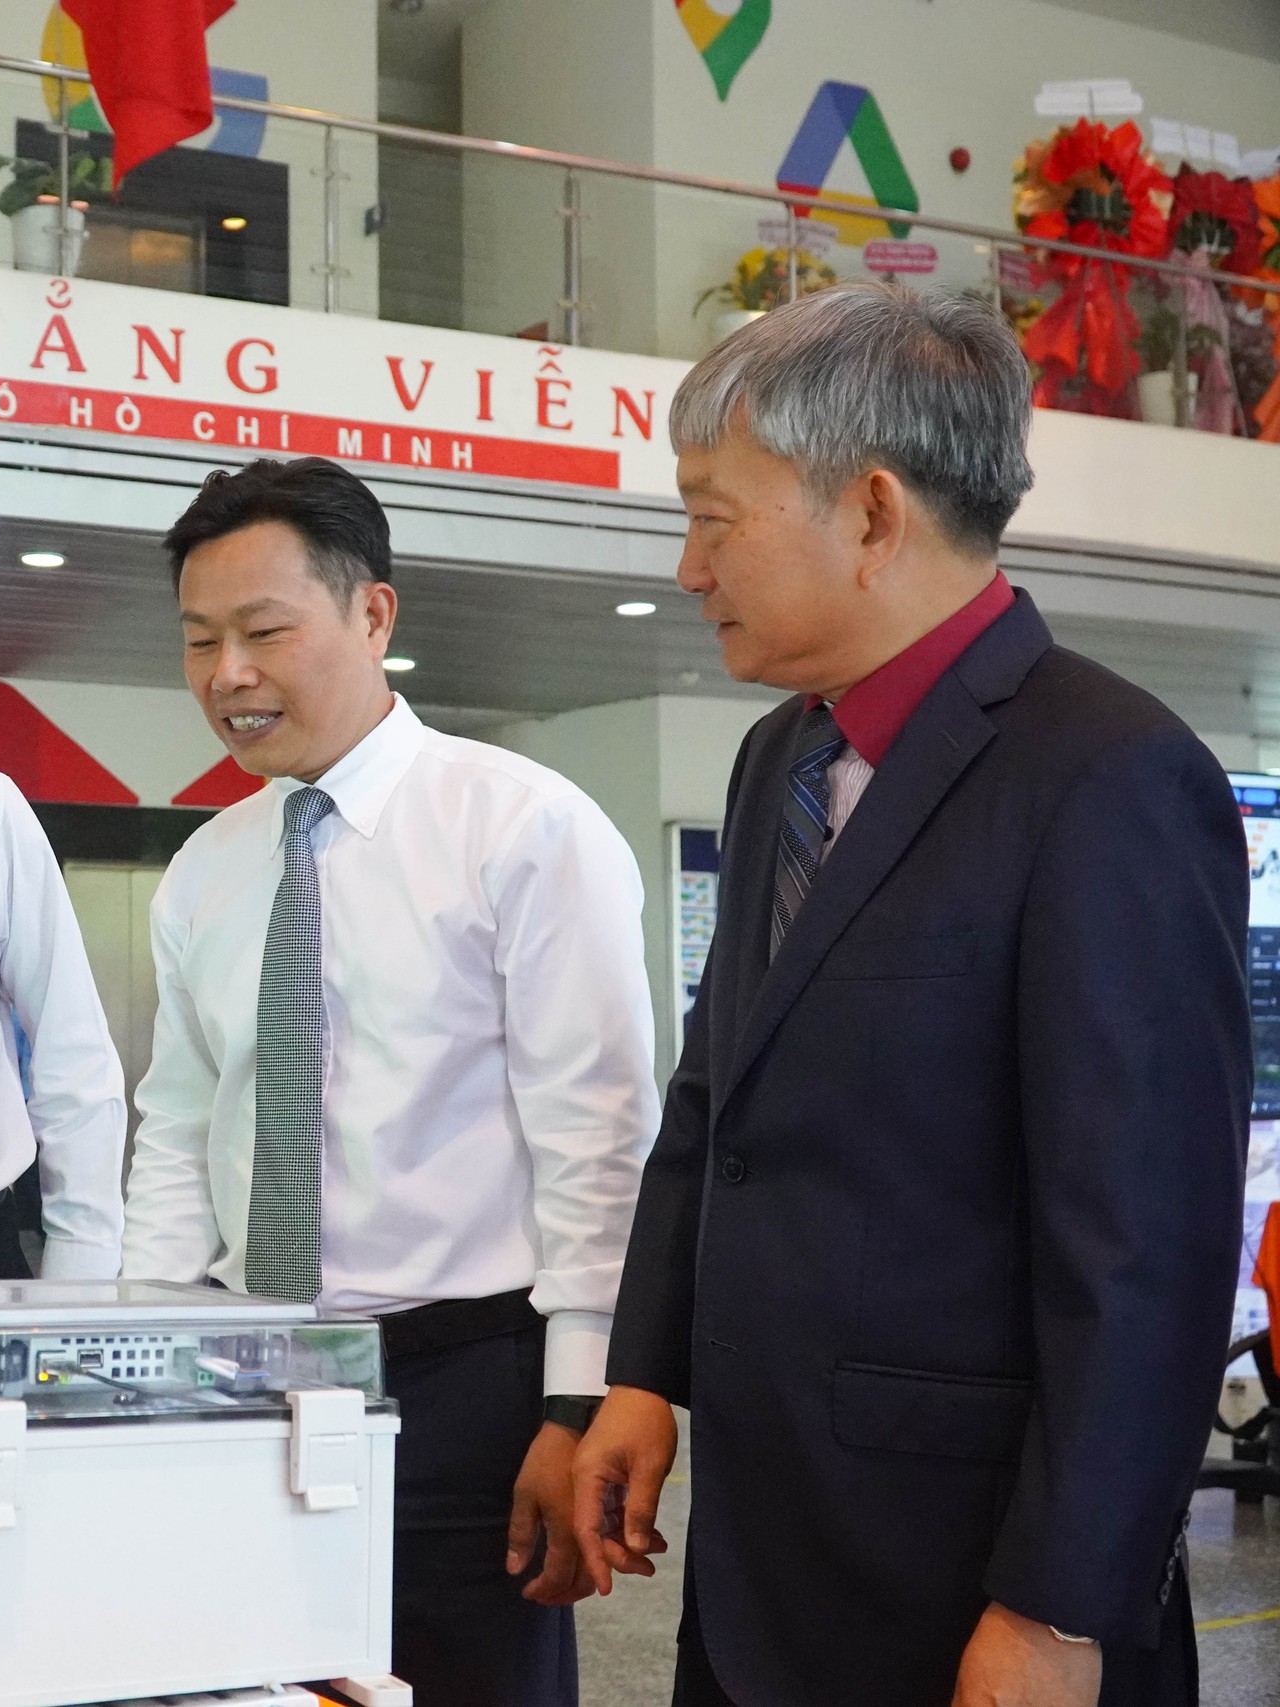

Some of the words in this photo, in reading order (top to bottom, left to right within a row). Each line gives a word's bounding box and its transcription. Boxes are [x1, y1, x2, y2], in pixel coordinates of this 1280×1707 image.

[386, 346, 655, 441] VIỄN
[192, 404, 289, 449] CHÍ
[338, 427, 473, 470] MINH
